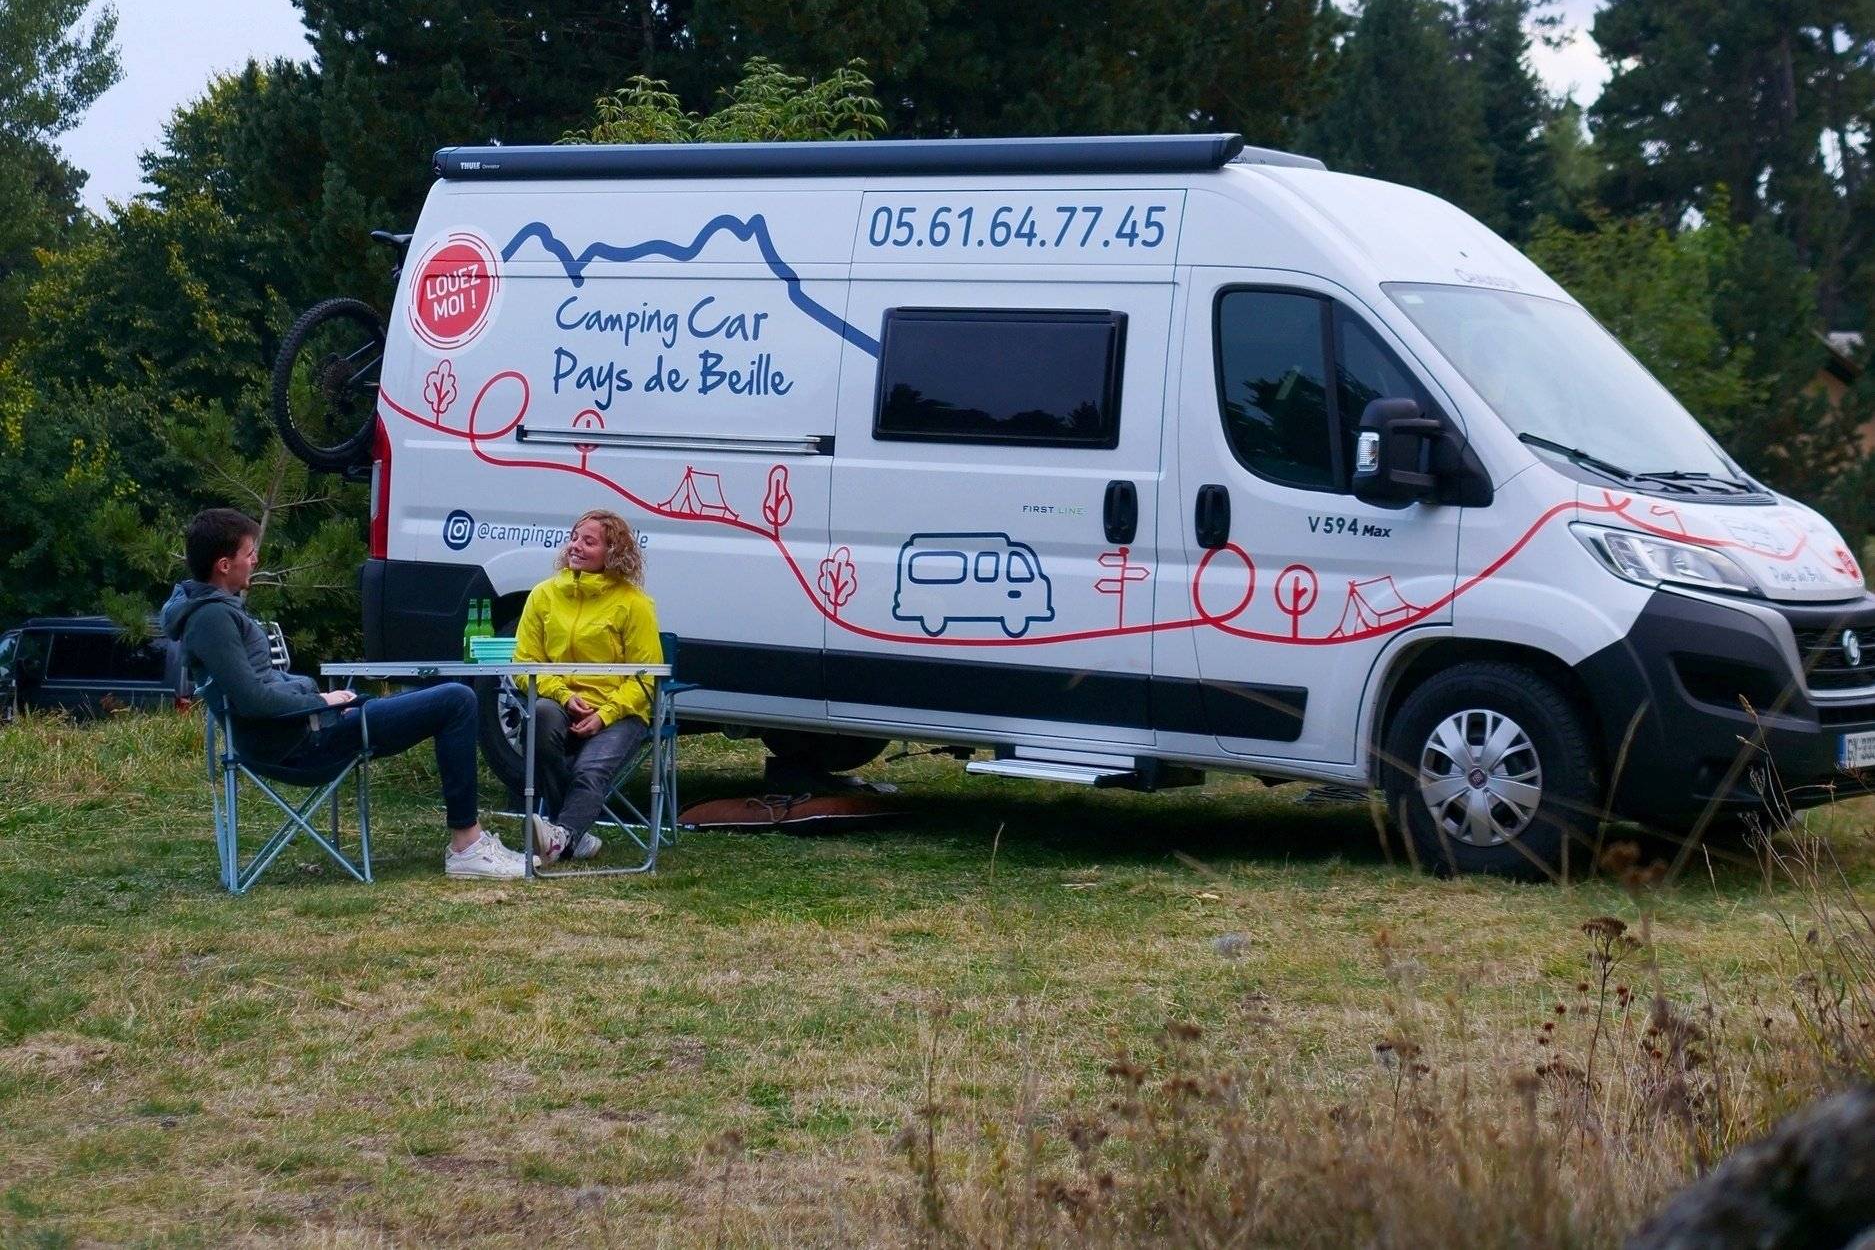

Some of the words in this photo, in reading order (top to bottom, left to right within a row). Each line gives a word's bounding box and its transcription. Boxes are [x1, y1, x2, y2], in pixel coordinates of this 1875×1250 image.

[460, 161, 481, 170] THULE
[868, 205, 1167, 248] 05.61.64.77.45
[426, 263, 481, 300] LOUEZ
[433, 293, 465, 322] MOI
[555, 295, 680, 349] Camping
[687, 295, 769, 342] Car
[553, 346, 633, 411] Pays
[643, 354, 690, 393] de
[697, 349, 794, 396] Beille
[1022, 505, 1055, 514] FIRST
[1058, 507, 1085, 516] LINE
[1361, 524, 1393, 538] Max
